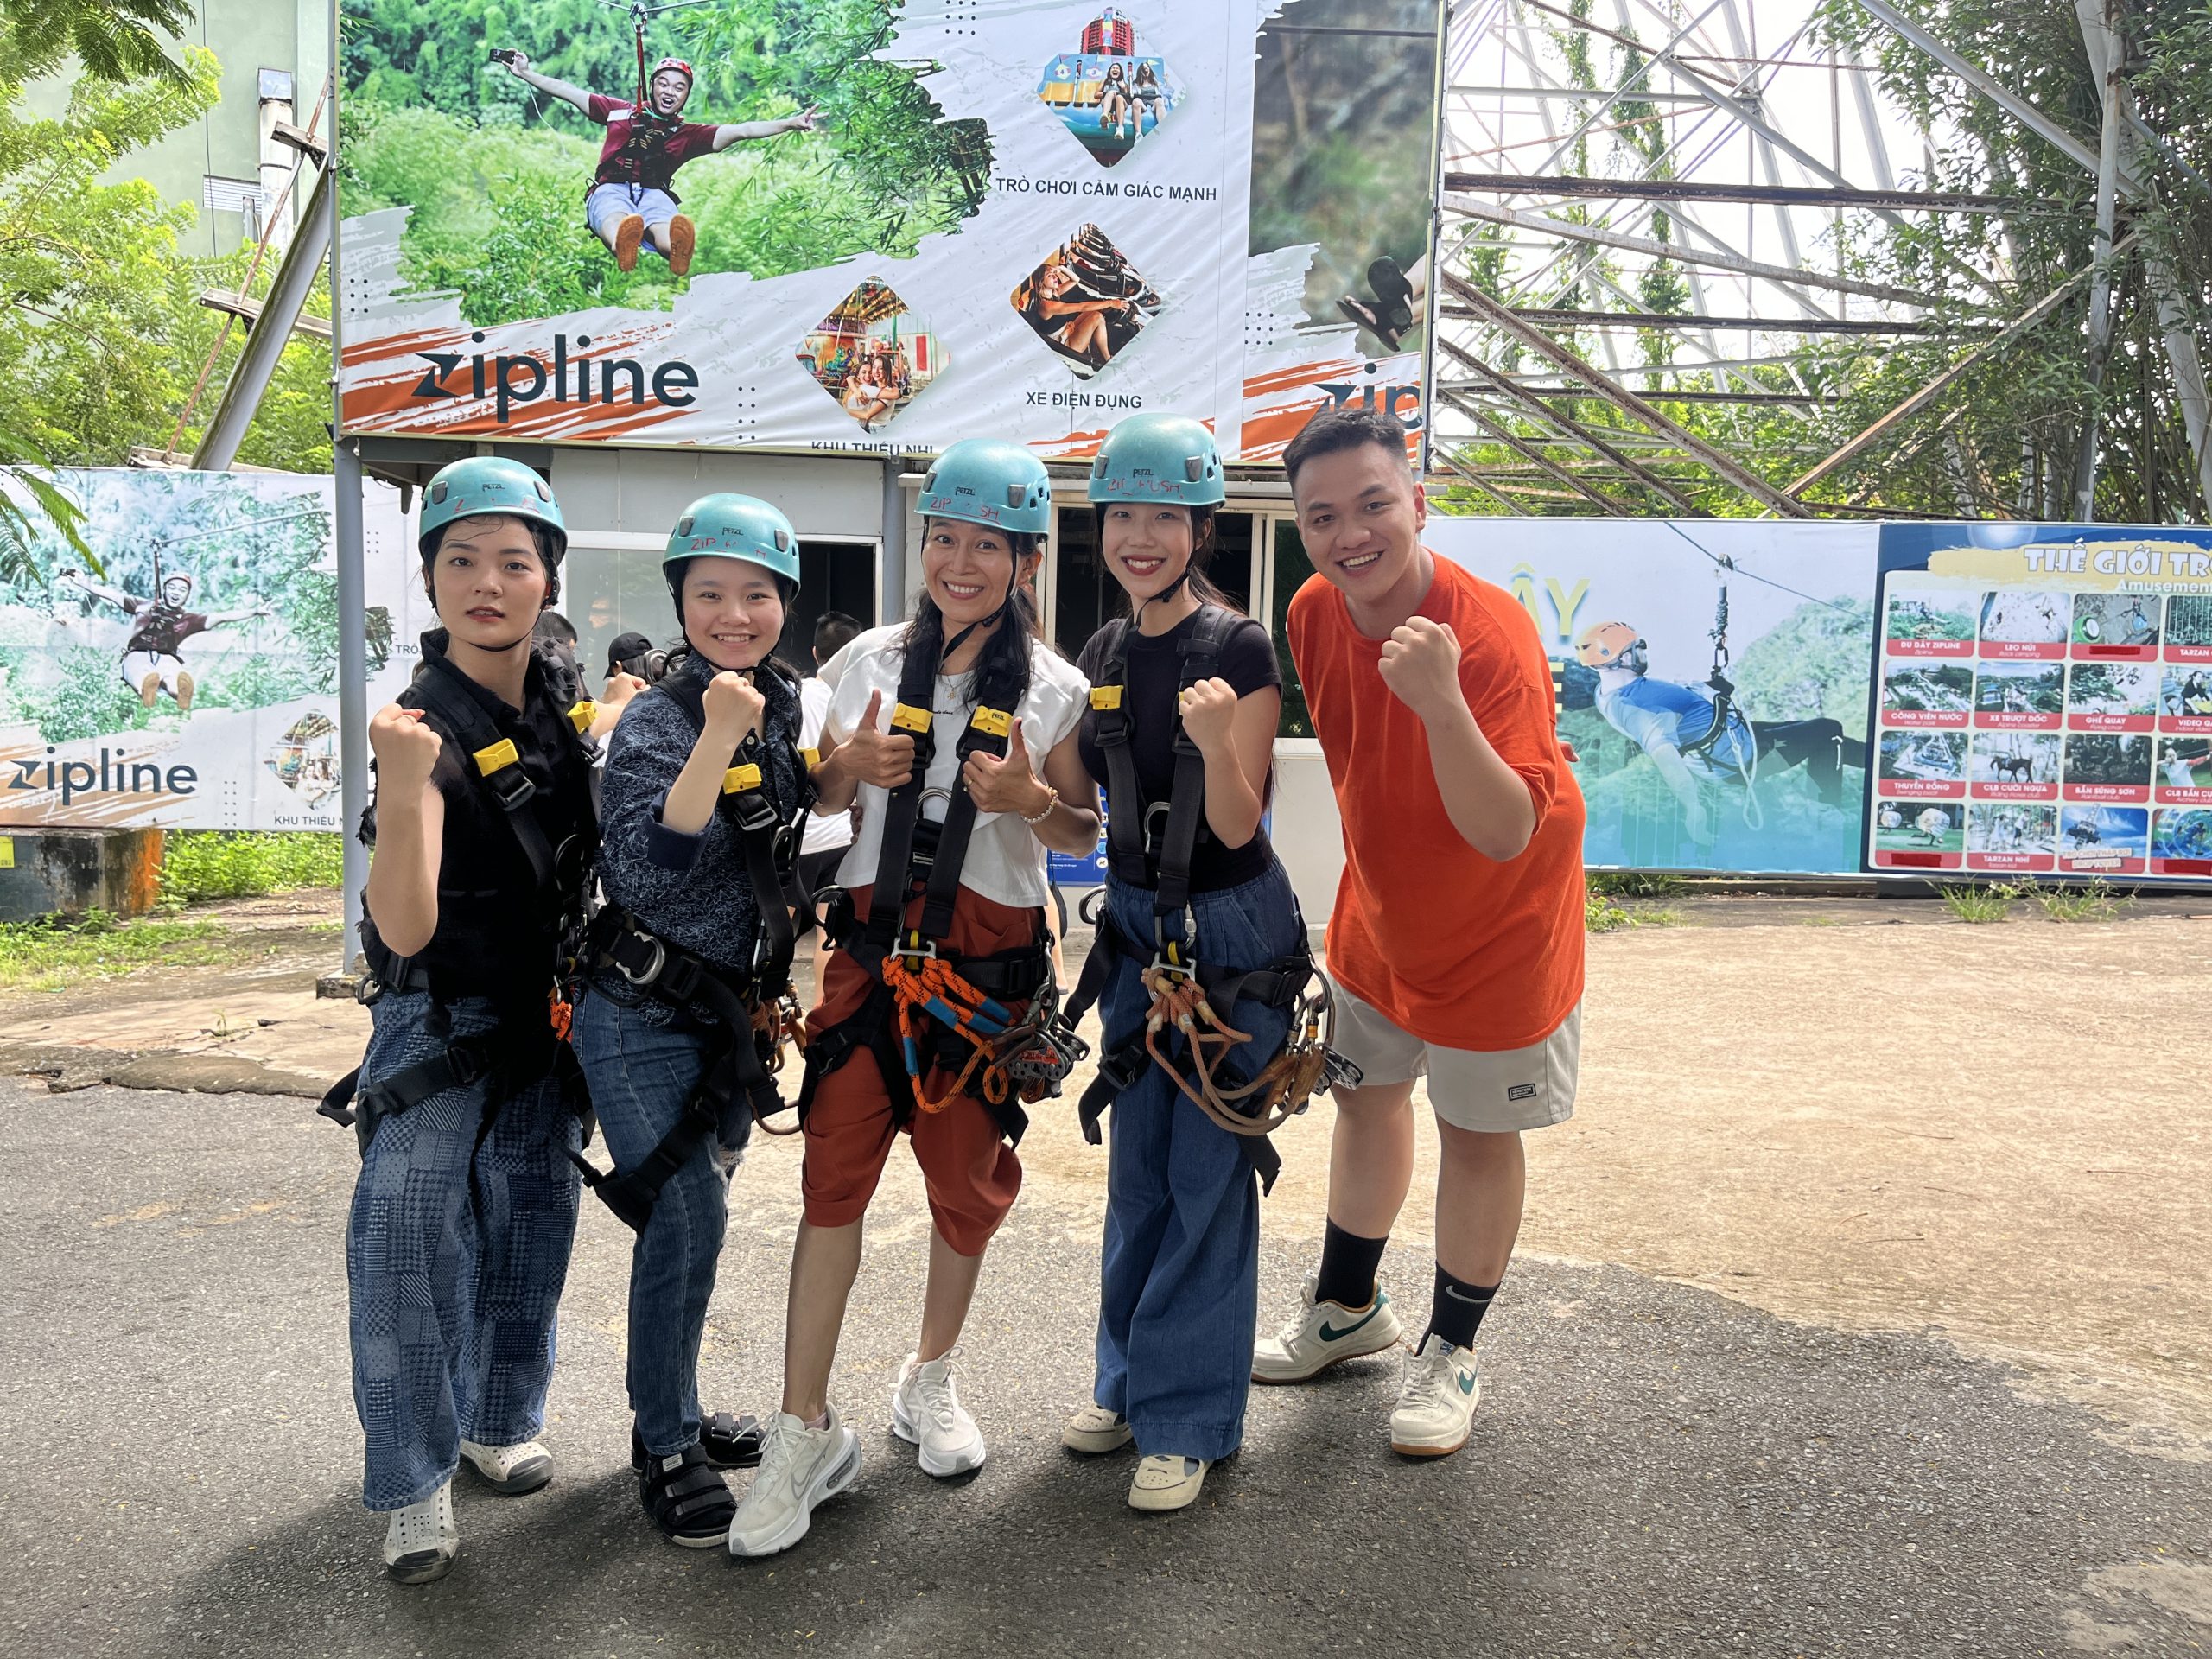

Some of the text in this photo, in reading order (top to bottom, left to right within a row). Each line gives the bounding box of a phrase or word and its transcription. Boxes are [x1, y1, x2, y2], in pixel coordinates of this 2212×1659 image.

[995, 175, 1217, 203] TRÒ CHƠI CẢM GIÁC MẠNH
[410, 331, 699, 423] zipline
[1026, 391, 1047, 405] XE
[1095, 394, 1141, 411] ĐỤNG
[1133, 469, 1154, 478] PETZL
[955, 486, 975, 495] PETZL
[931, 497, 952, 509] ZIP
[722, 527, 744, 536] PETZL
[691, 537, 716, 550] ZIP
[2024, 537, 2212, 578] THẾ GIỚI TR
[7, 746, 198, 806] zipline
[274, 816, 298, 825] KHU
